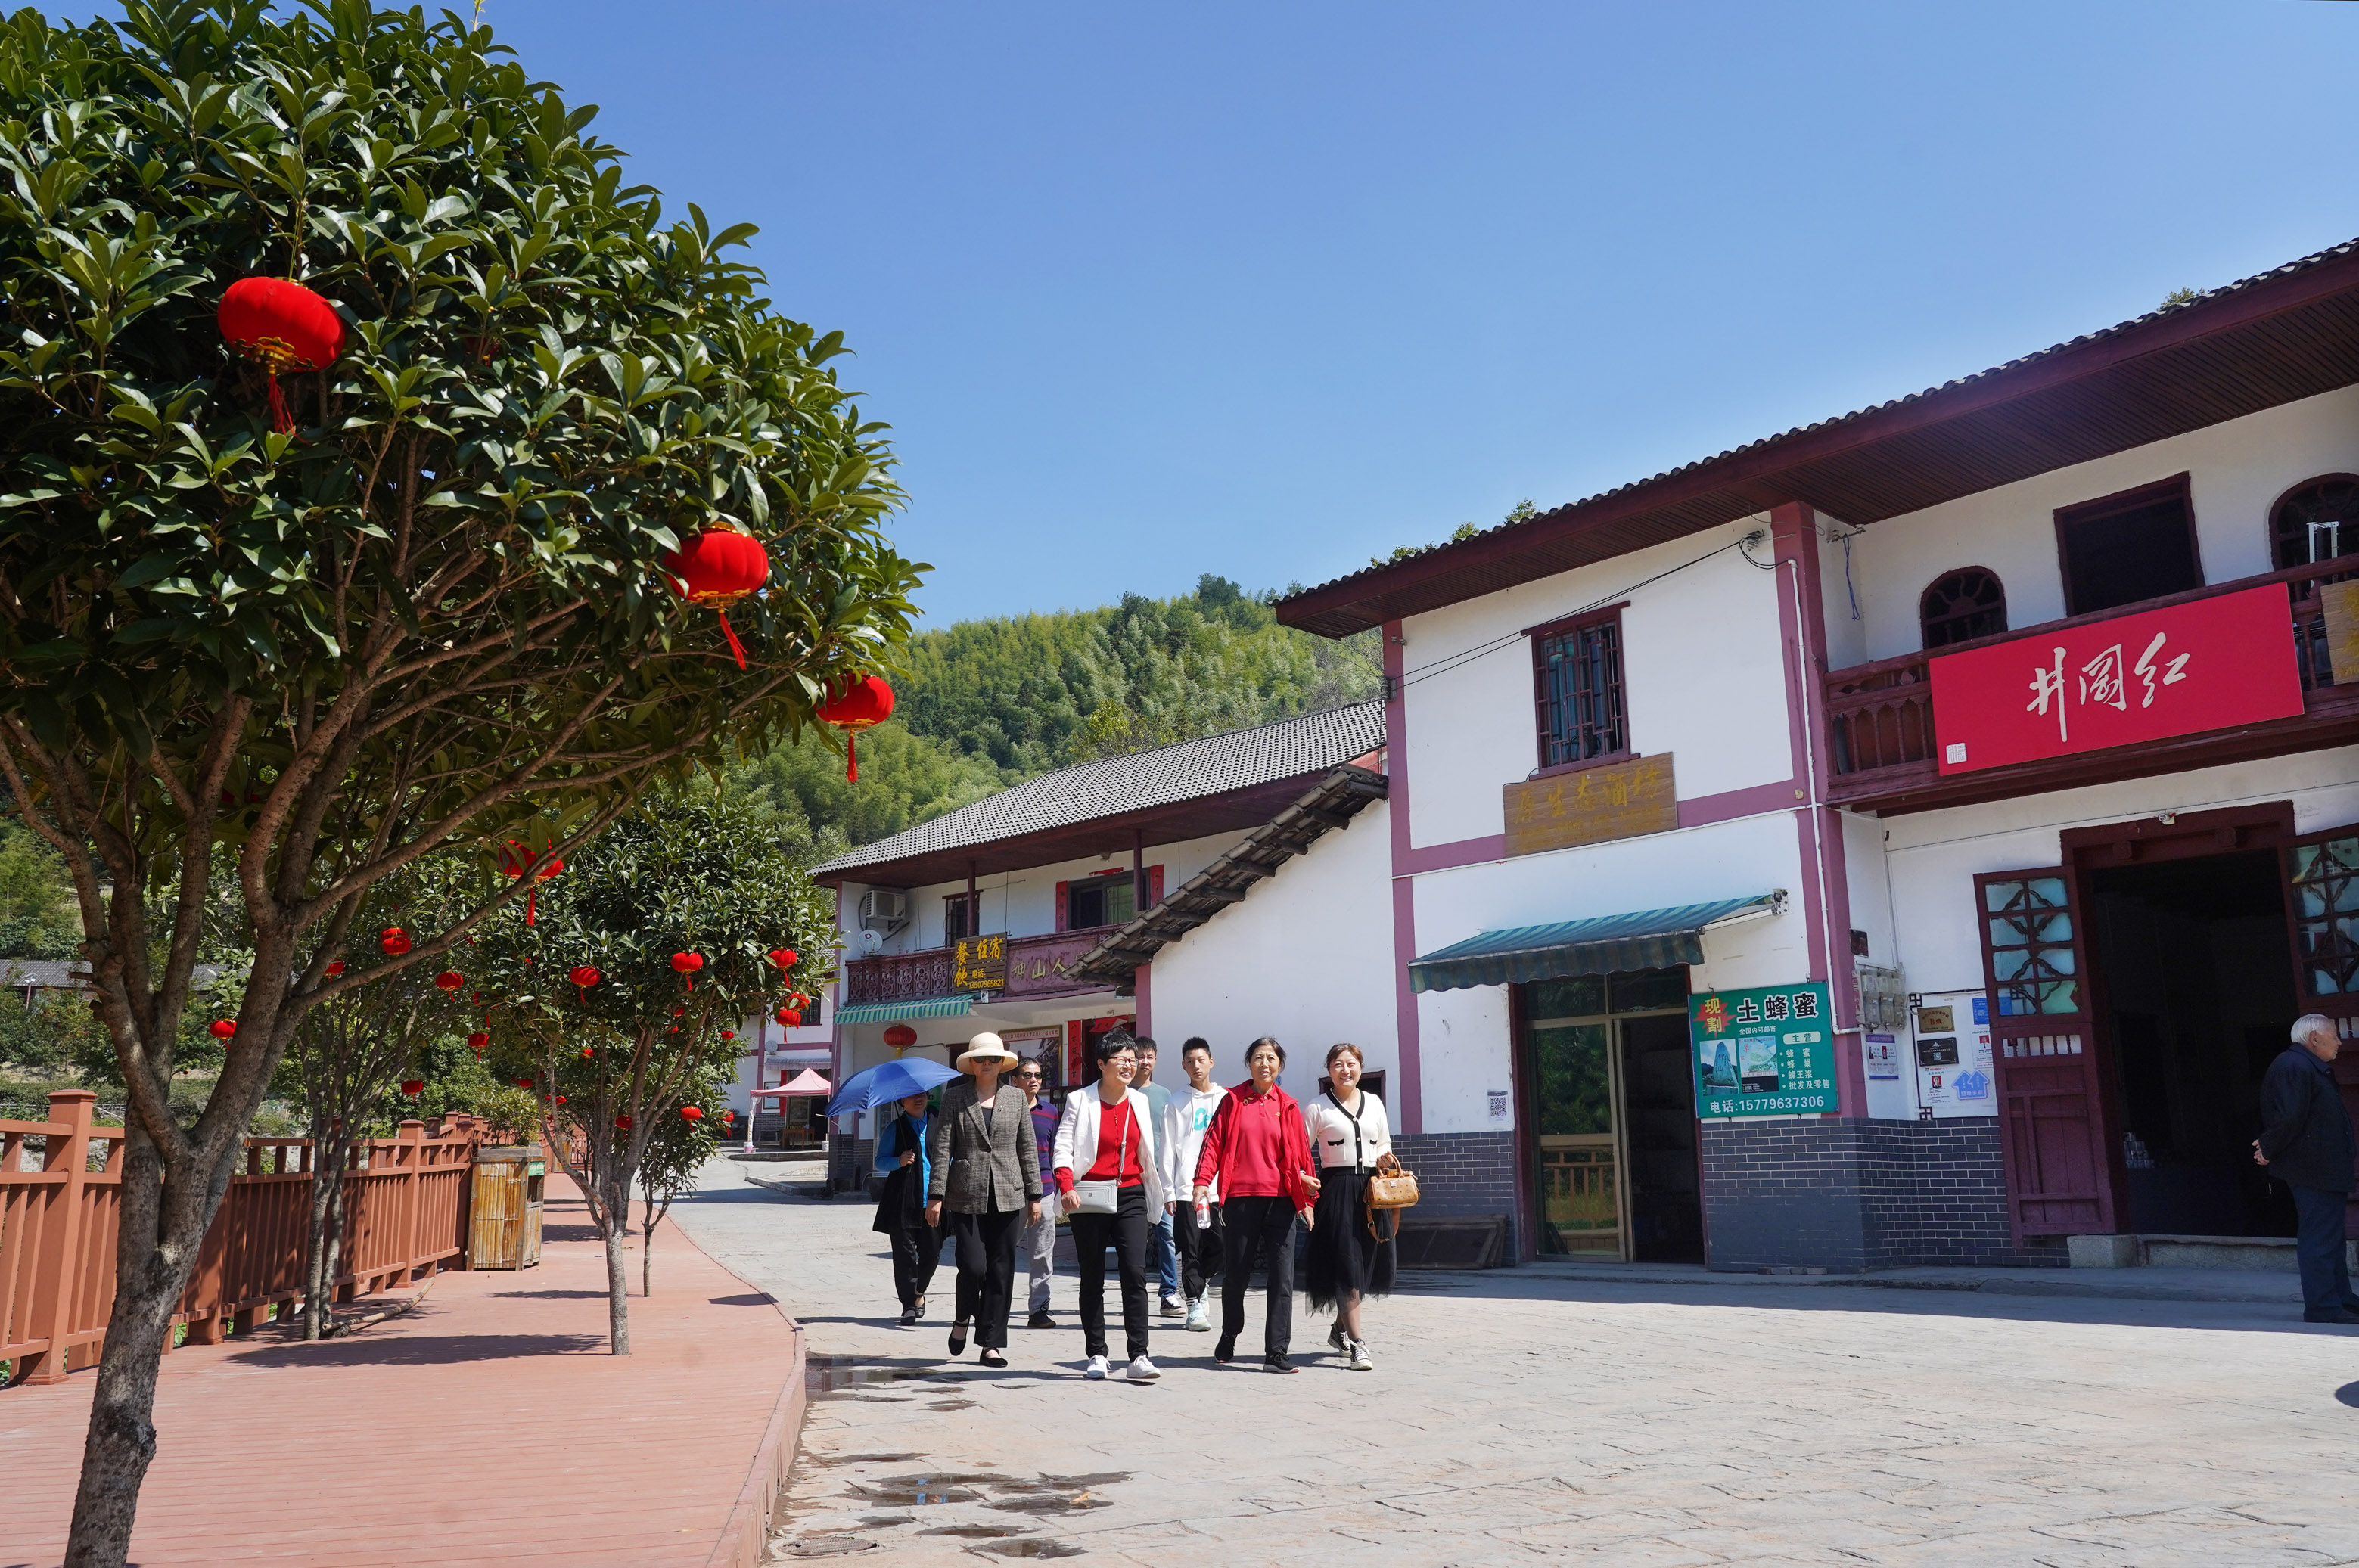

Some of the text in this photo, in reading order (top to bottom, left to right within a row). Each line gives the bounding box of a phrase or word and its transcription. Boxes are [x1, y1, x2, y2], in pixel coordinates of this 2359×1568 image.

[977, 936, 1002, 960] 住宿
[954, 942, 970, 987] 餐饮
[969, 978, 1004, 989] 13507965821
[1737, 992, 1818, 1023] 土蜂蜜
[1705, 998, 1723, 1033] 现割
[1739, 1025, 1776, 1036] 全国内可邮寄
[1792, 1033, 1812, 1043] 主营
[1788, 1070, 1813, 1079] 蜂王浆
[1789, 1079, 1830, 1090] 批发及零售
